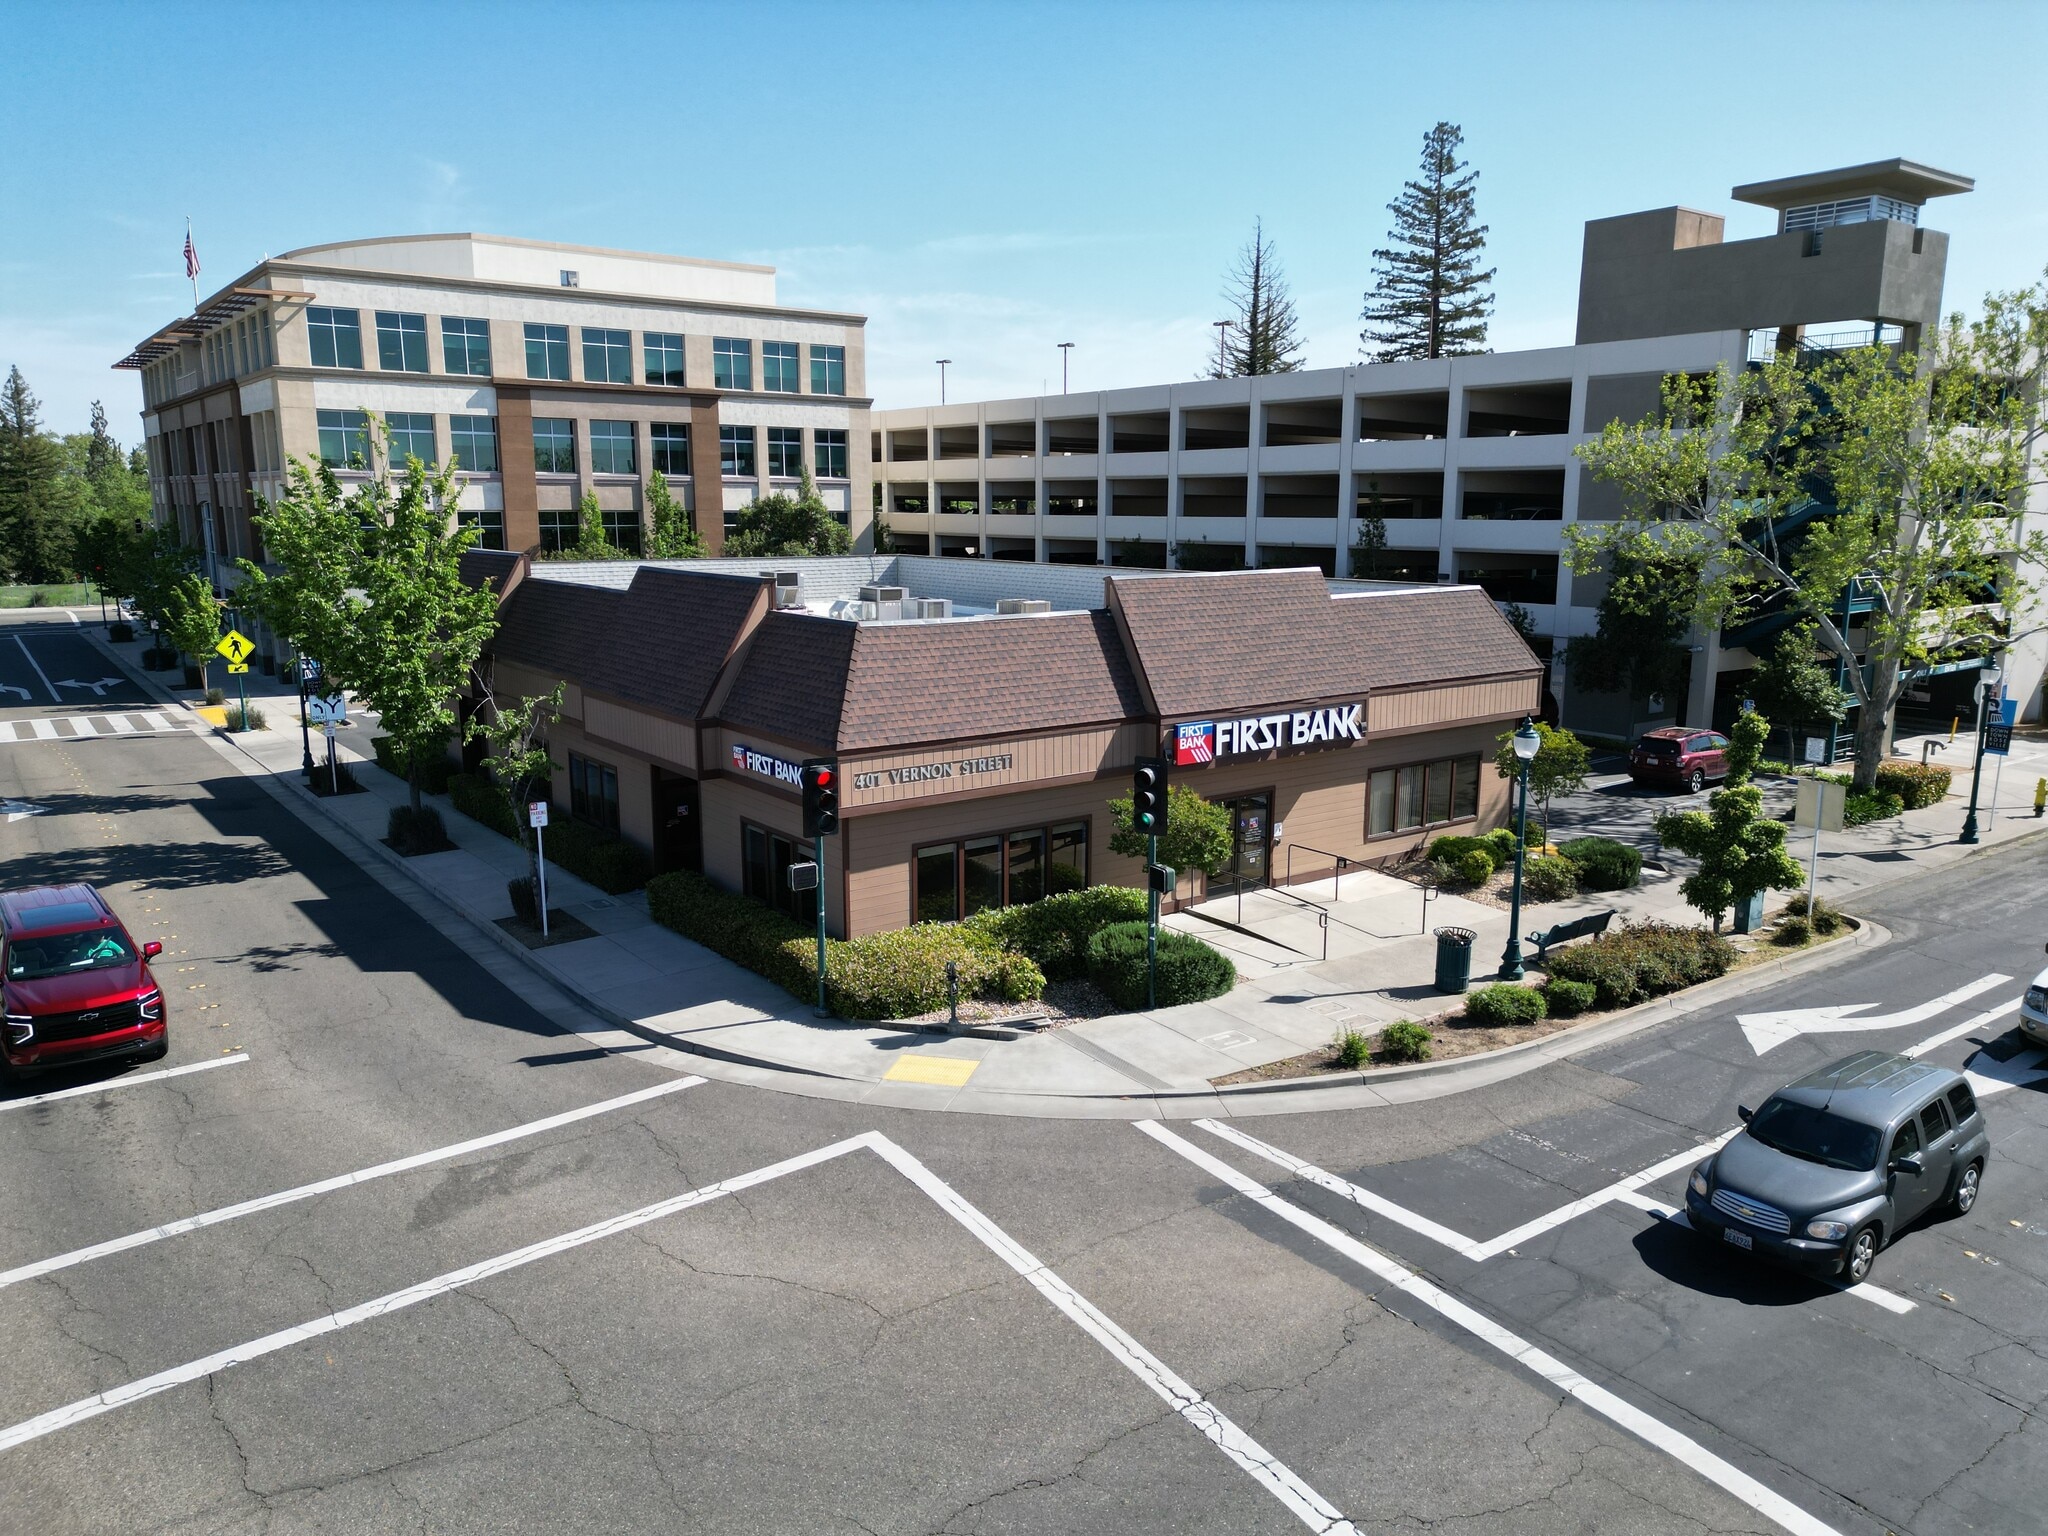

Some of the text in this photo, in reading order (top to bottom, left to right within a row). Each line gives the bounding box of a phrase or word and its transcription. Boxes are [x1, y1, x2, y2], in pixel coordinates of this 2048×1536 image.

[1180, 723, 1213, 737] FIRST
[1180, 735, 1206, 750] BANK
[1214, 704, 1363, 757] FIRST BANK
[746, 751, 803, 789] FIRST BANK
[855, 756, 1012, 789] 401 VERNON STREET
